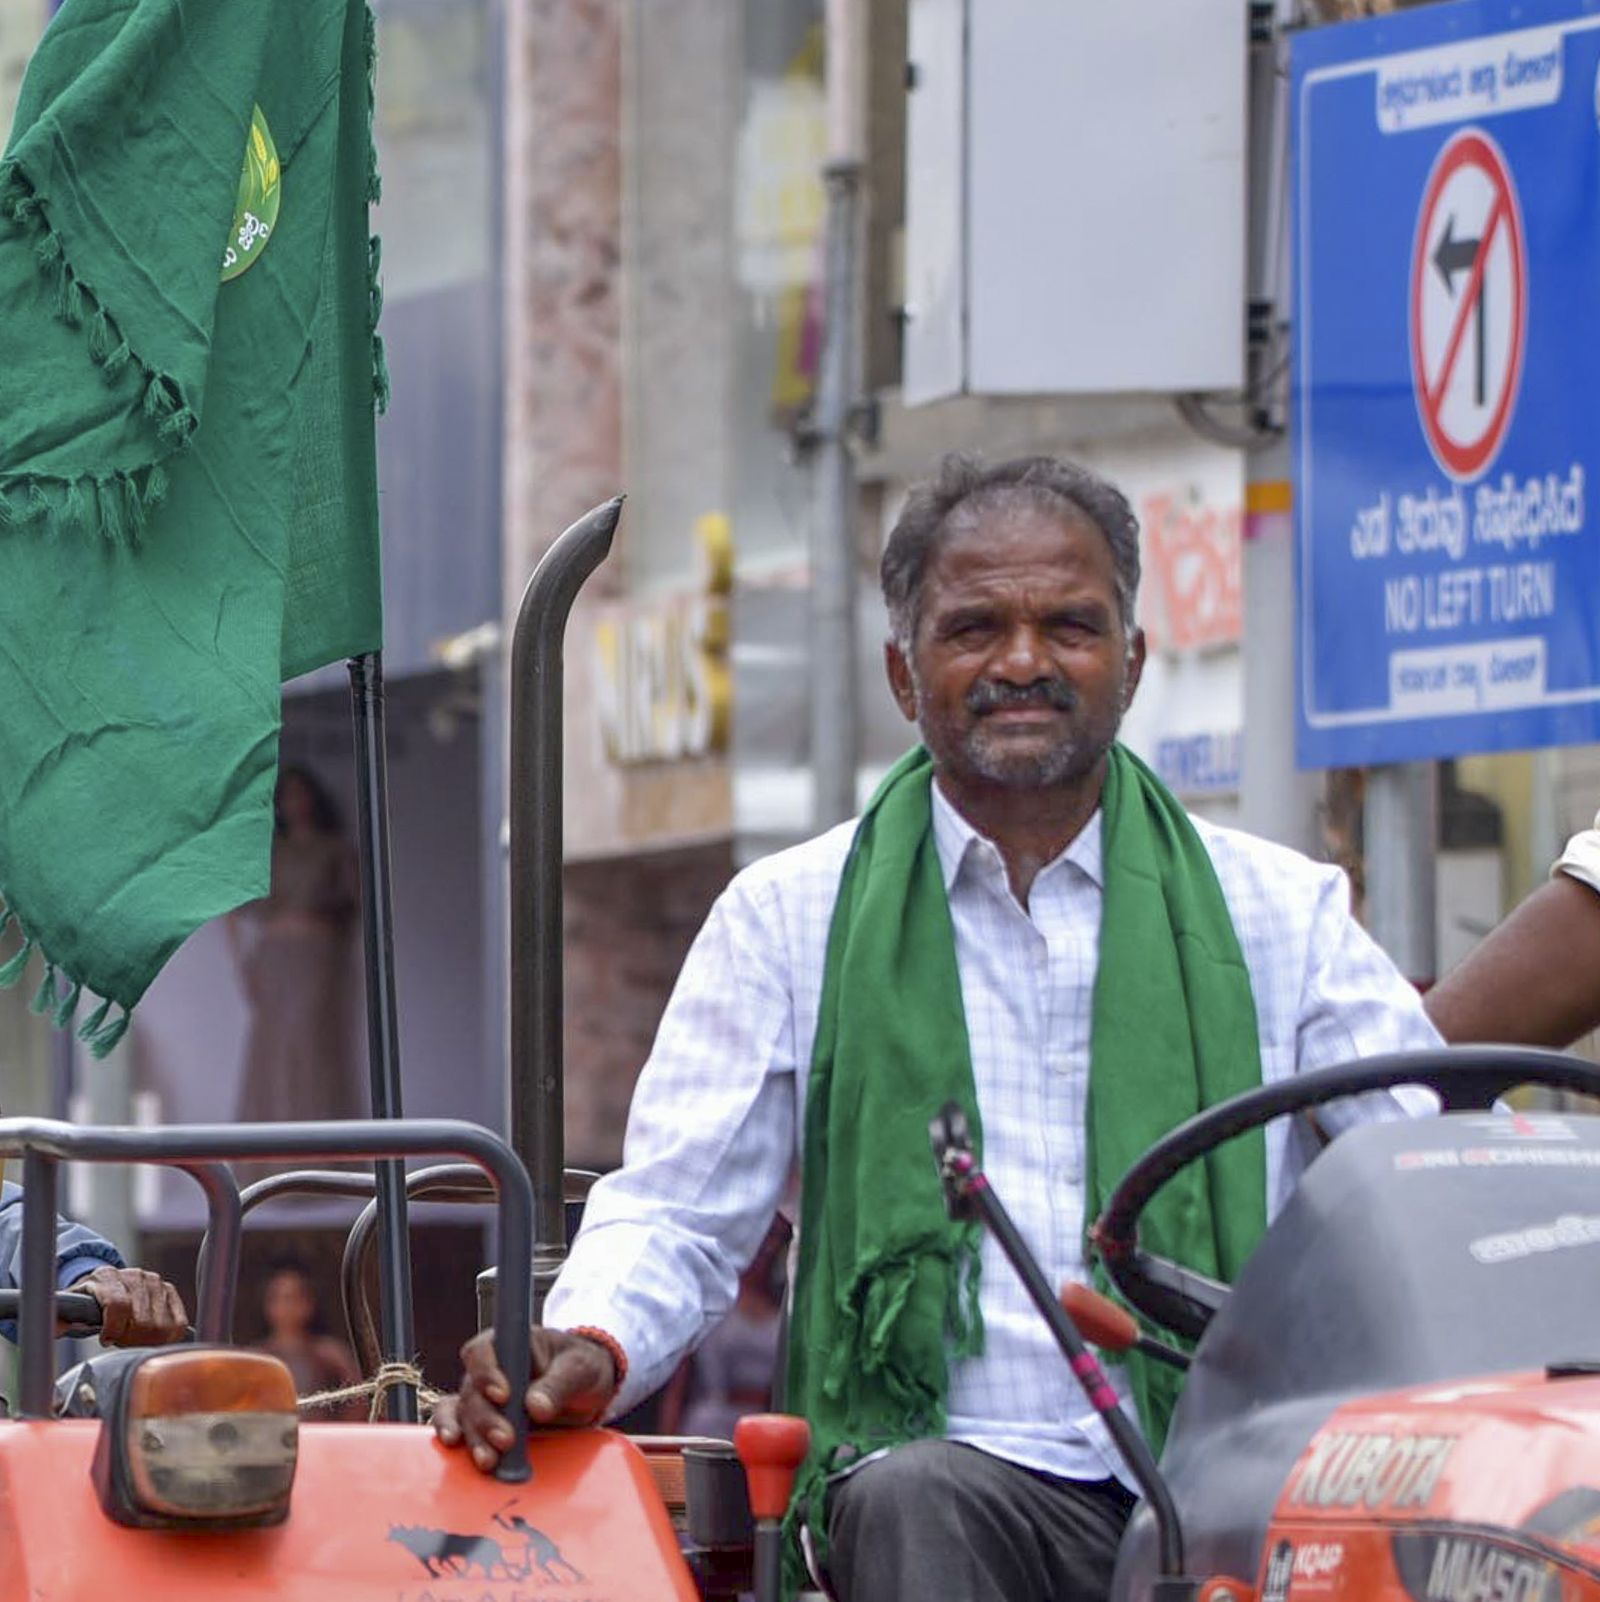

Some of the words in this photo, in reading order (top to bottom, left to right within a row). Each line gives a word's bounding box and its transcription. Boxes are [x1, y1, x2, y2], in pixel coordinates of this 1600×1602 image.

[1385, 575, 1421, 632] NO
[1423, 566, 1481, 629] LEFT
[1487, 561, 1555, 622] TURN
[1286, 1434, 1460, 1509] KUBOTA
